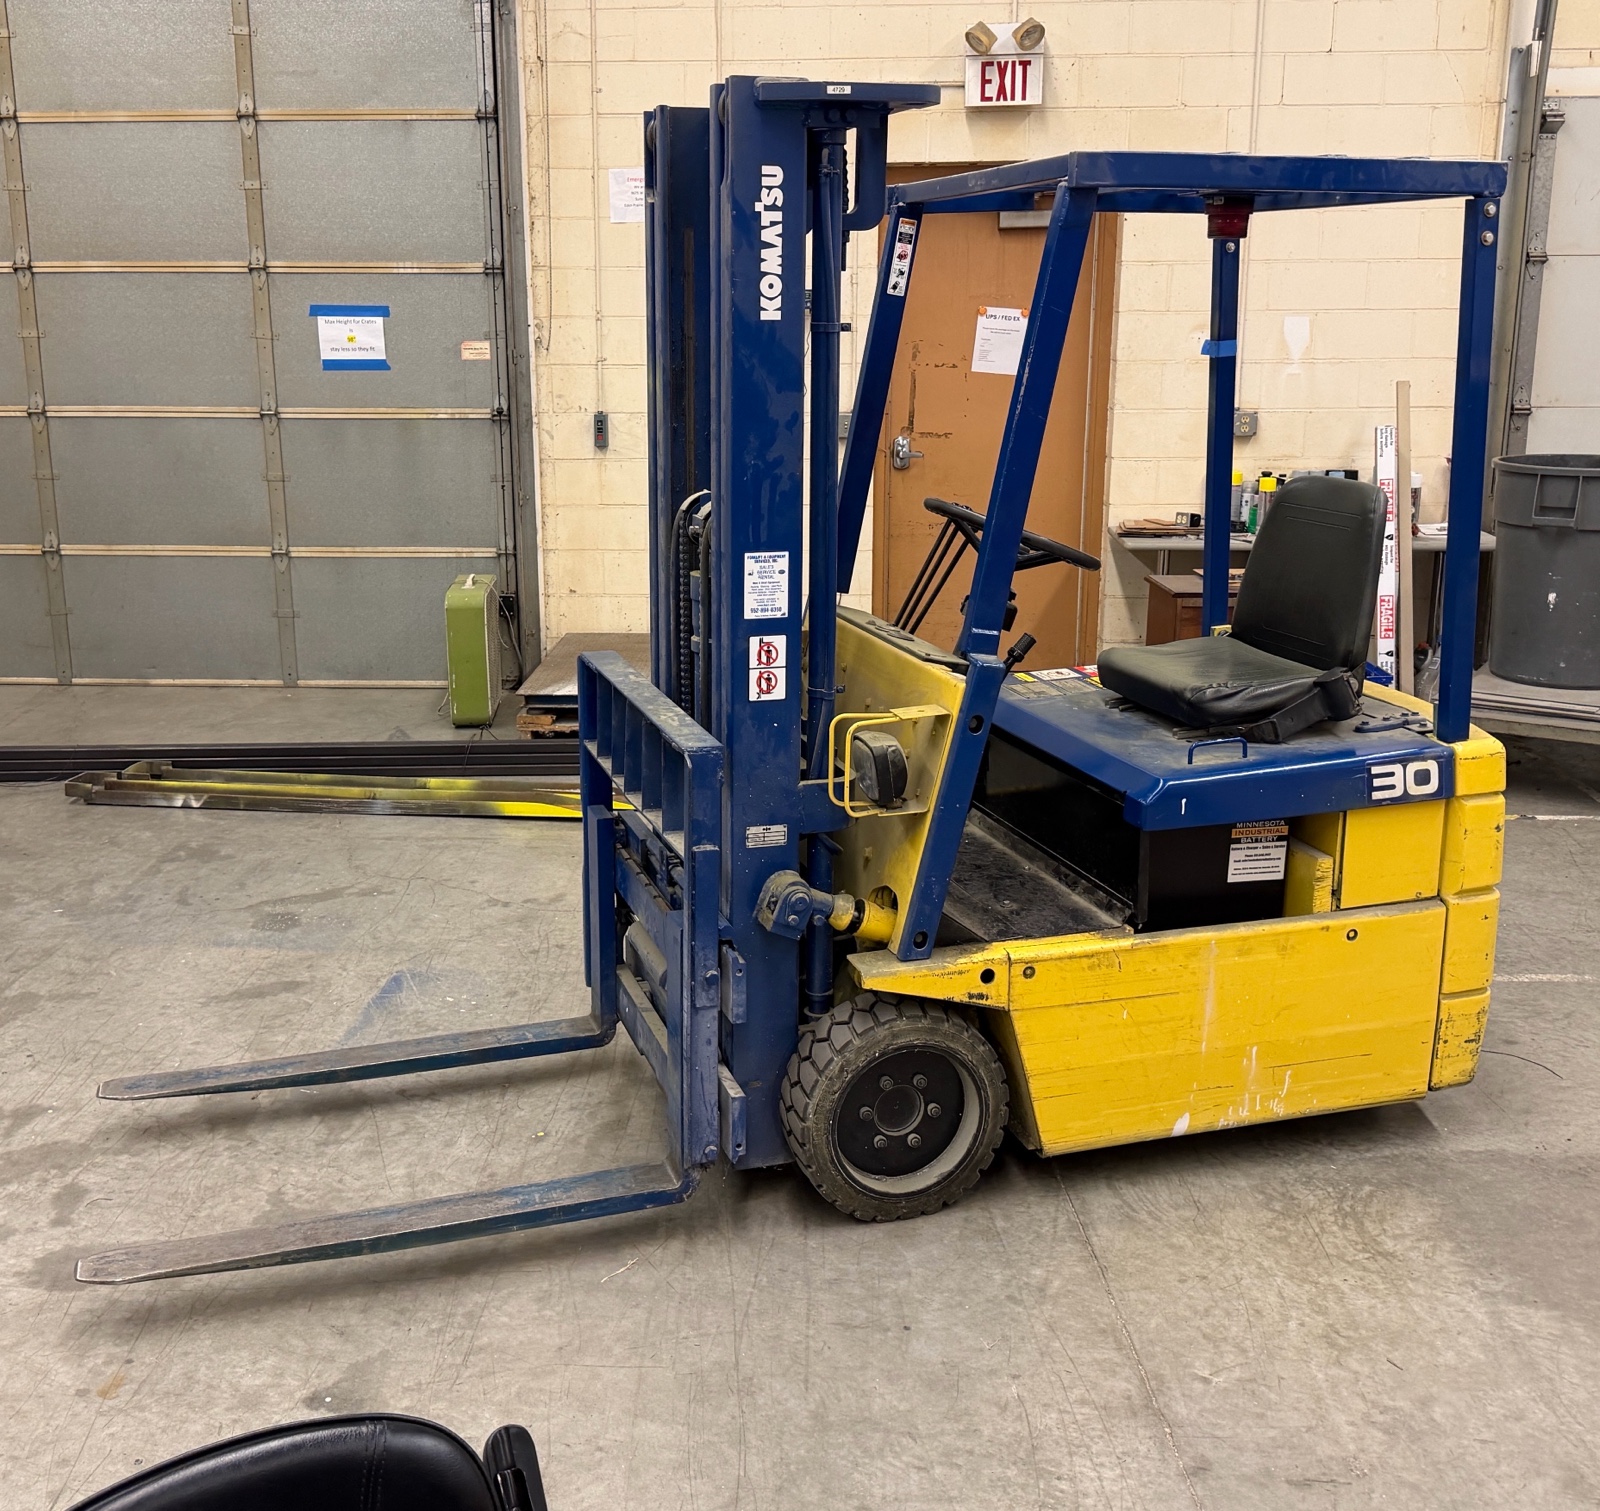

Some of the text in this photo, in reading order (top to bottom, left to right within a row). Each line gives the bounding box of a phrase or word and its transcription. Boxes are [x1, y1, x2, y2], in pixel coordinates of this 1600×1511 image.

[980, 60, 1031, 102] EXIT
[754, 165, 784, 321] KOMATSU
[1381, 596, 1393, 638] FRAGILE
[1371, 760, 1439, 800] 30
[1234, 827, 1286, 836] INDUSTRIAL
[1236, 820, 1286, 828] MINNESOTA
